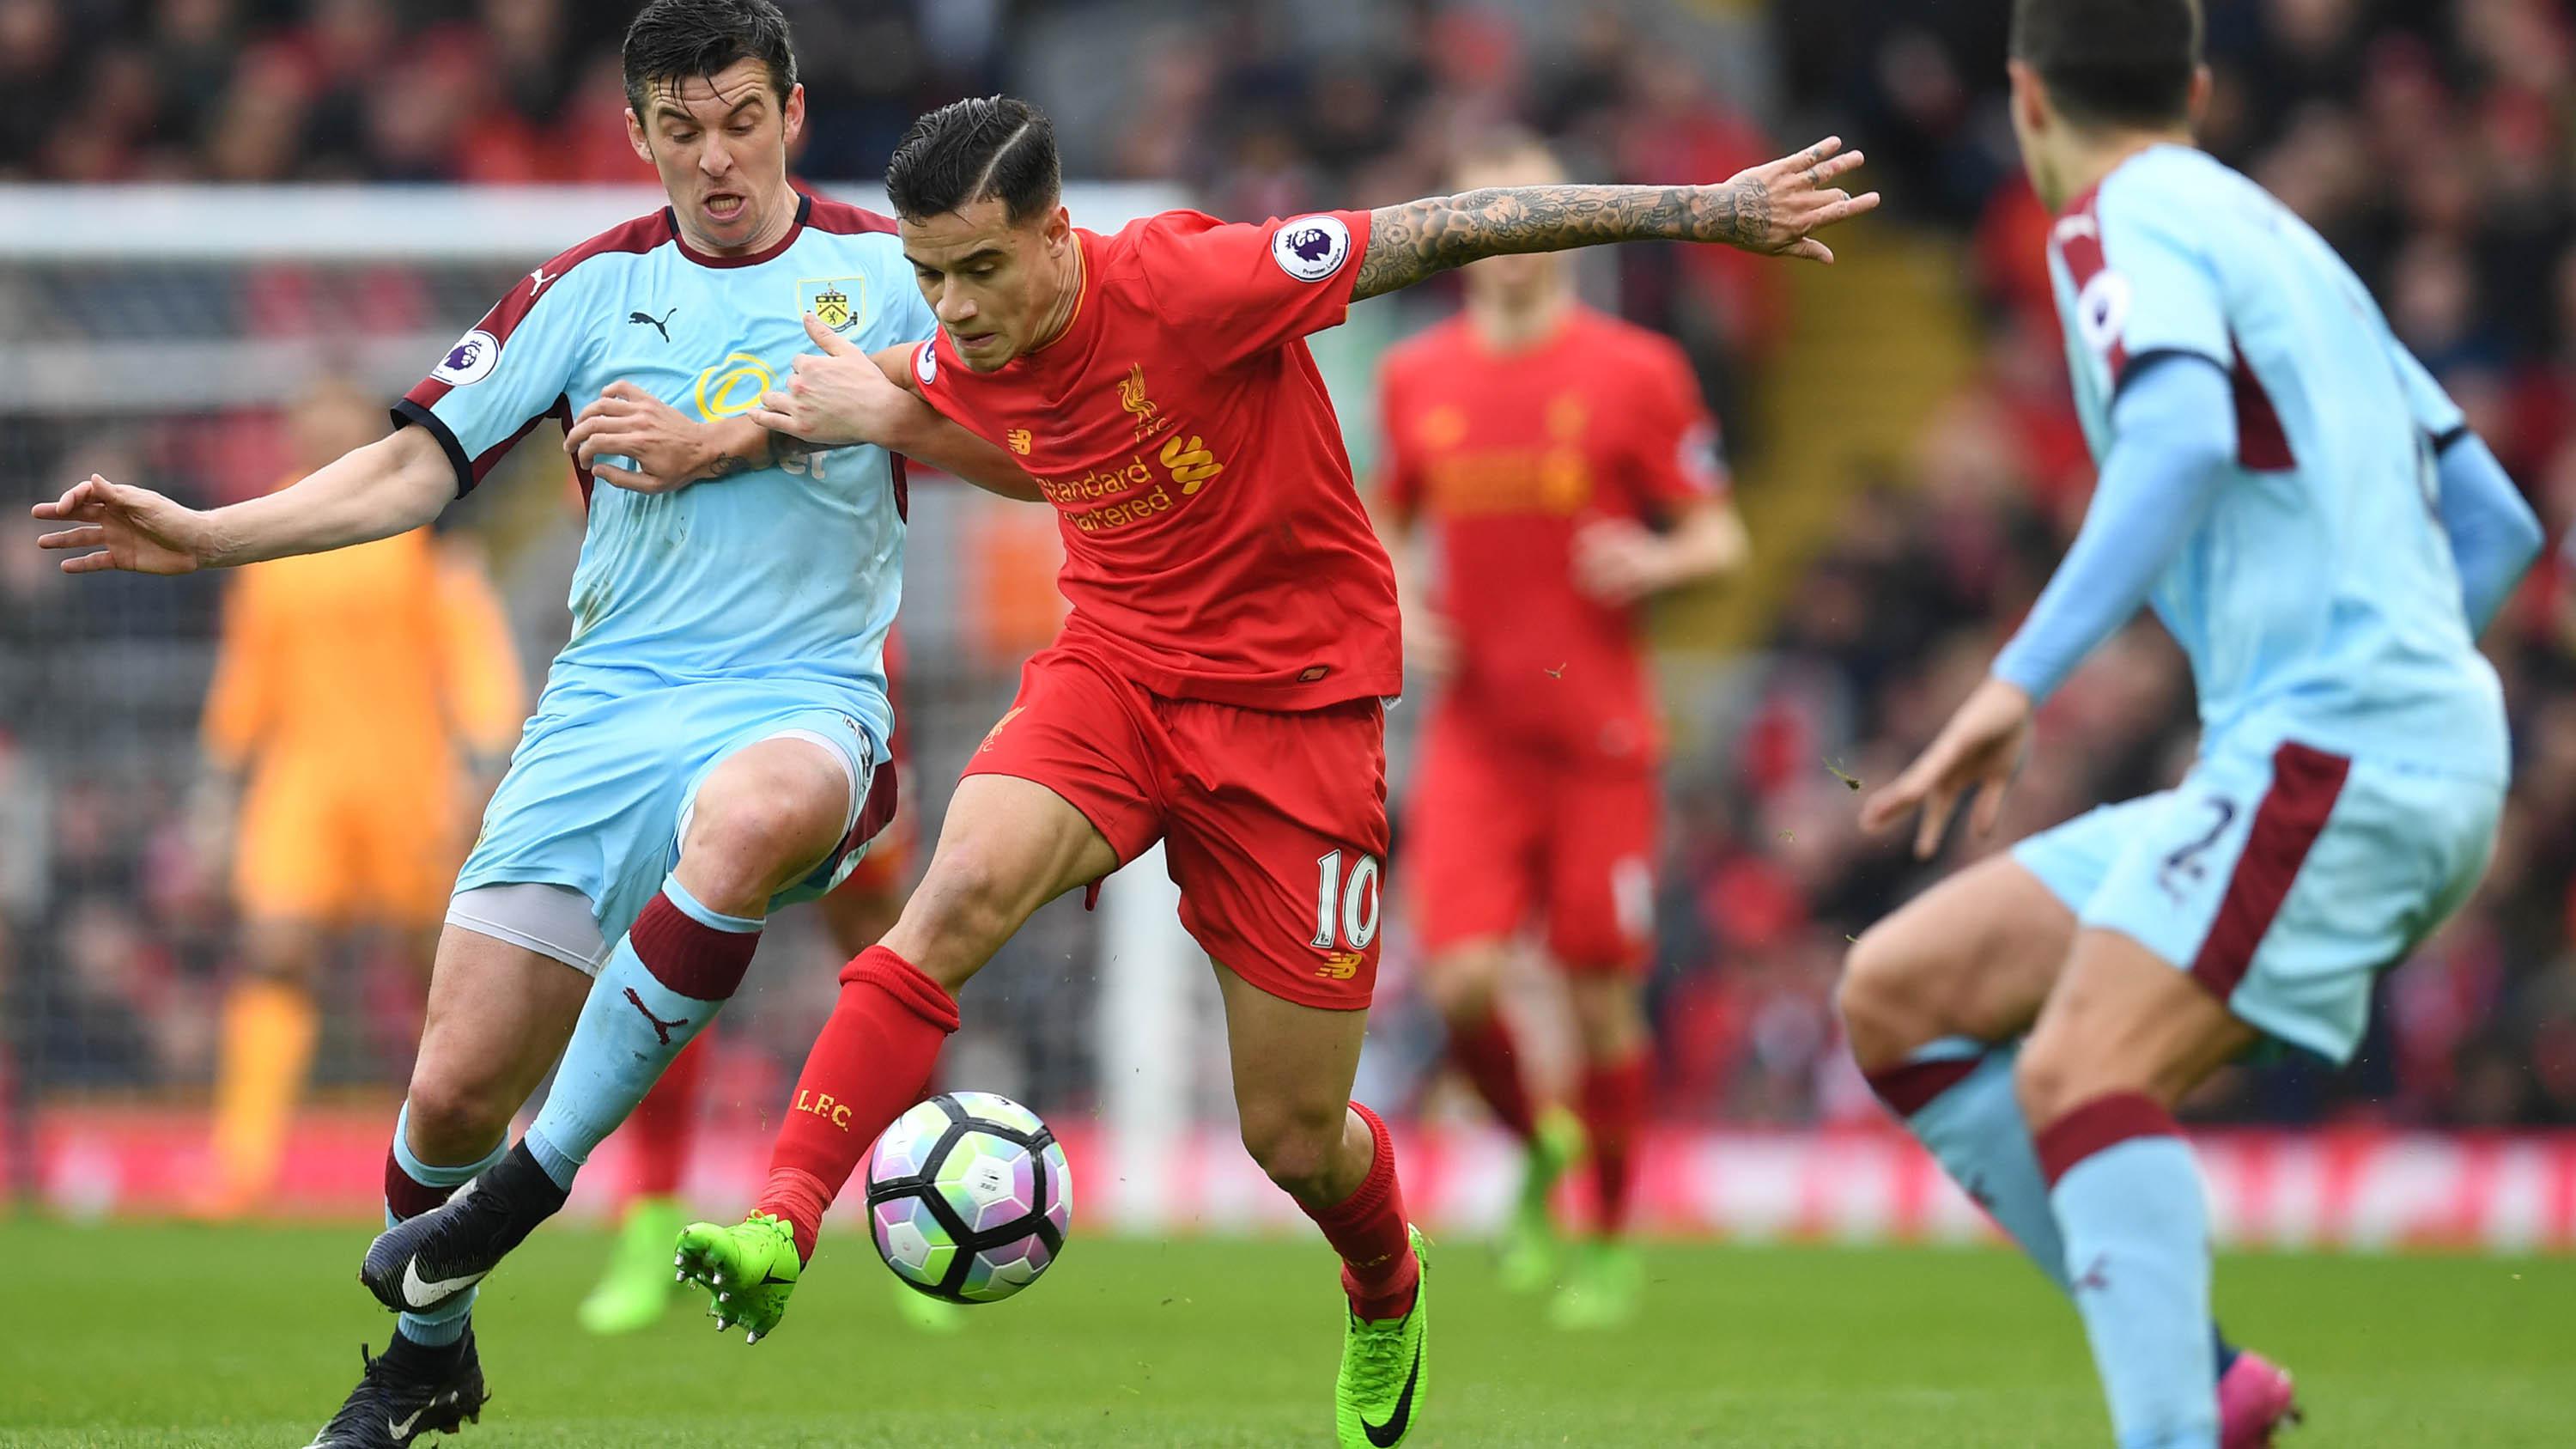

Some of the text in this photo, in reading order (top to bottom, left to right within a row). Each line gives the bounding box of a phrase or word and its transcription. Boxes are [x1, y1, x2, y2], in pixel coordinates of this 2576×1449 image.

[1036, 454, 1152, 502] Standard
[1310, 849, 1379, 949] 10
[795, 1089, 853, 1133] L.F.C.
